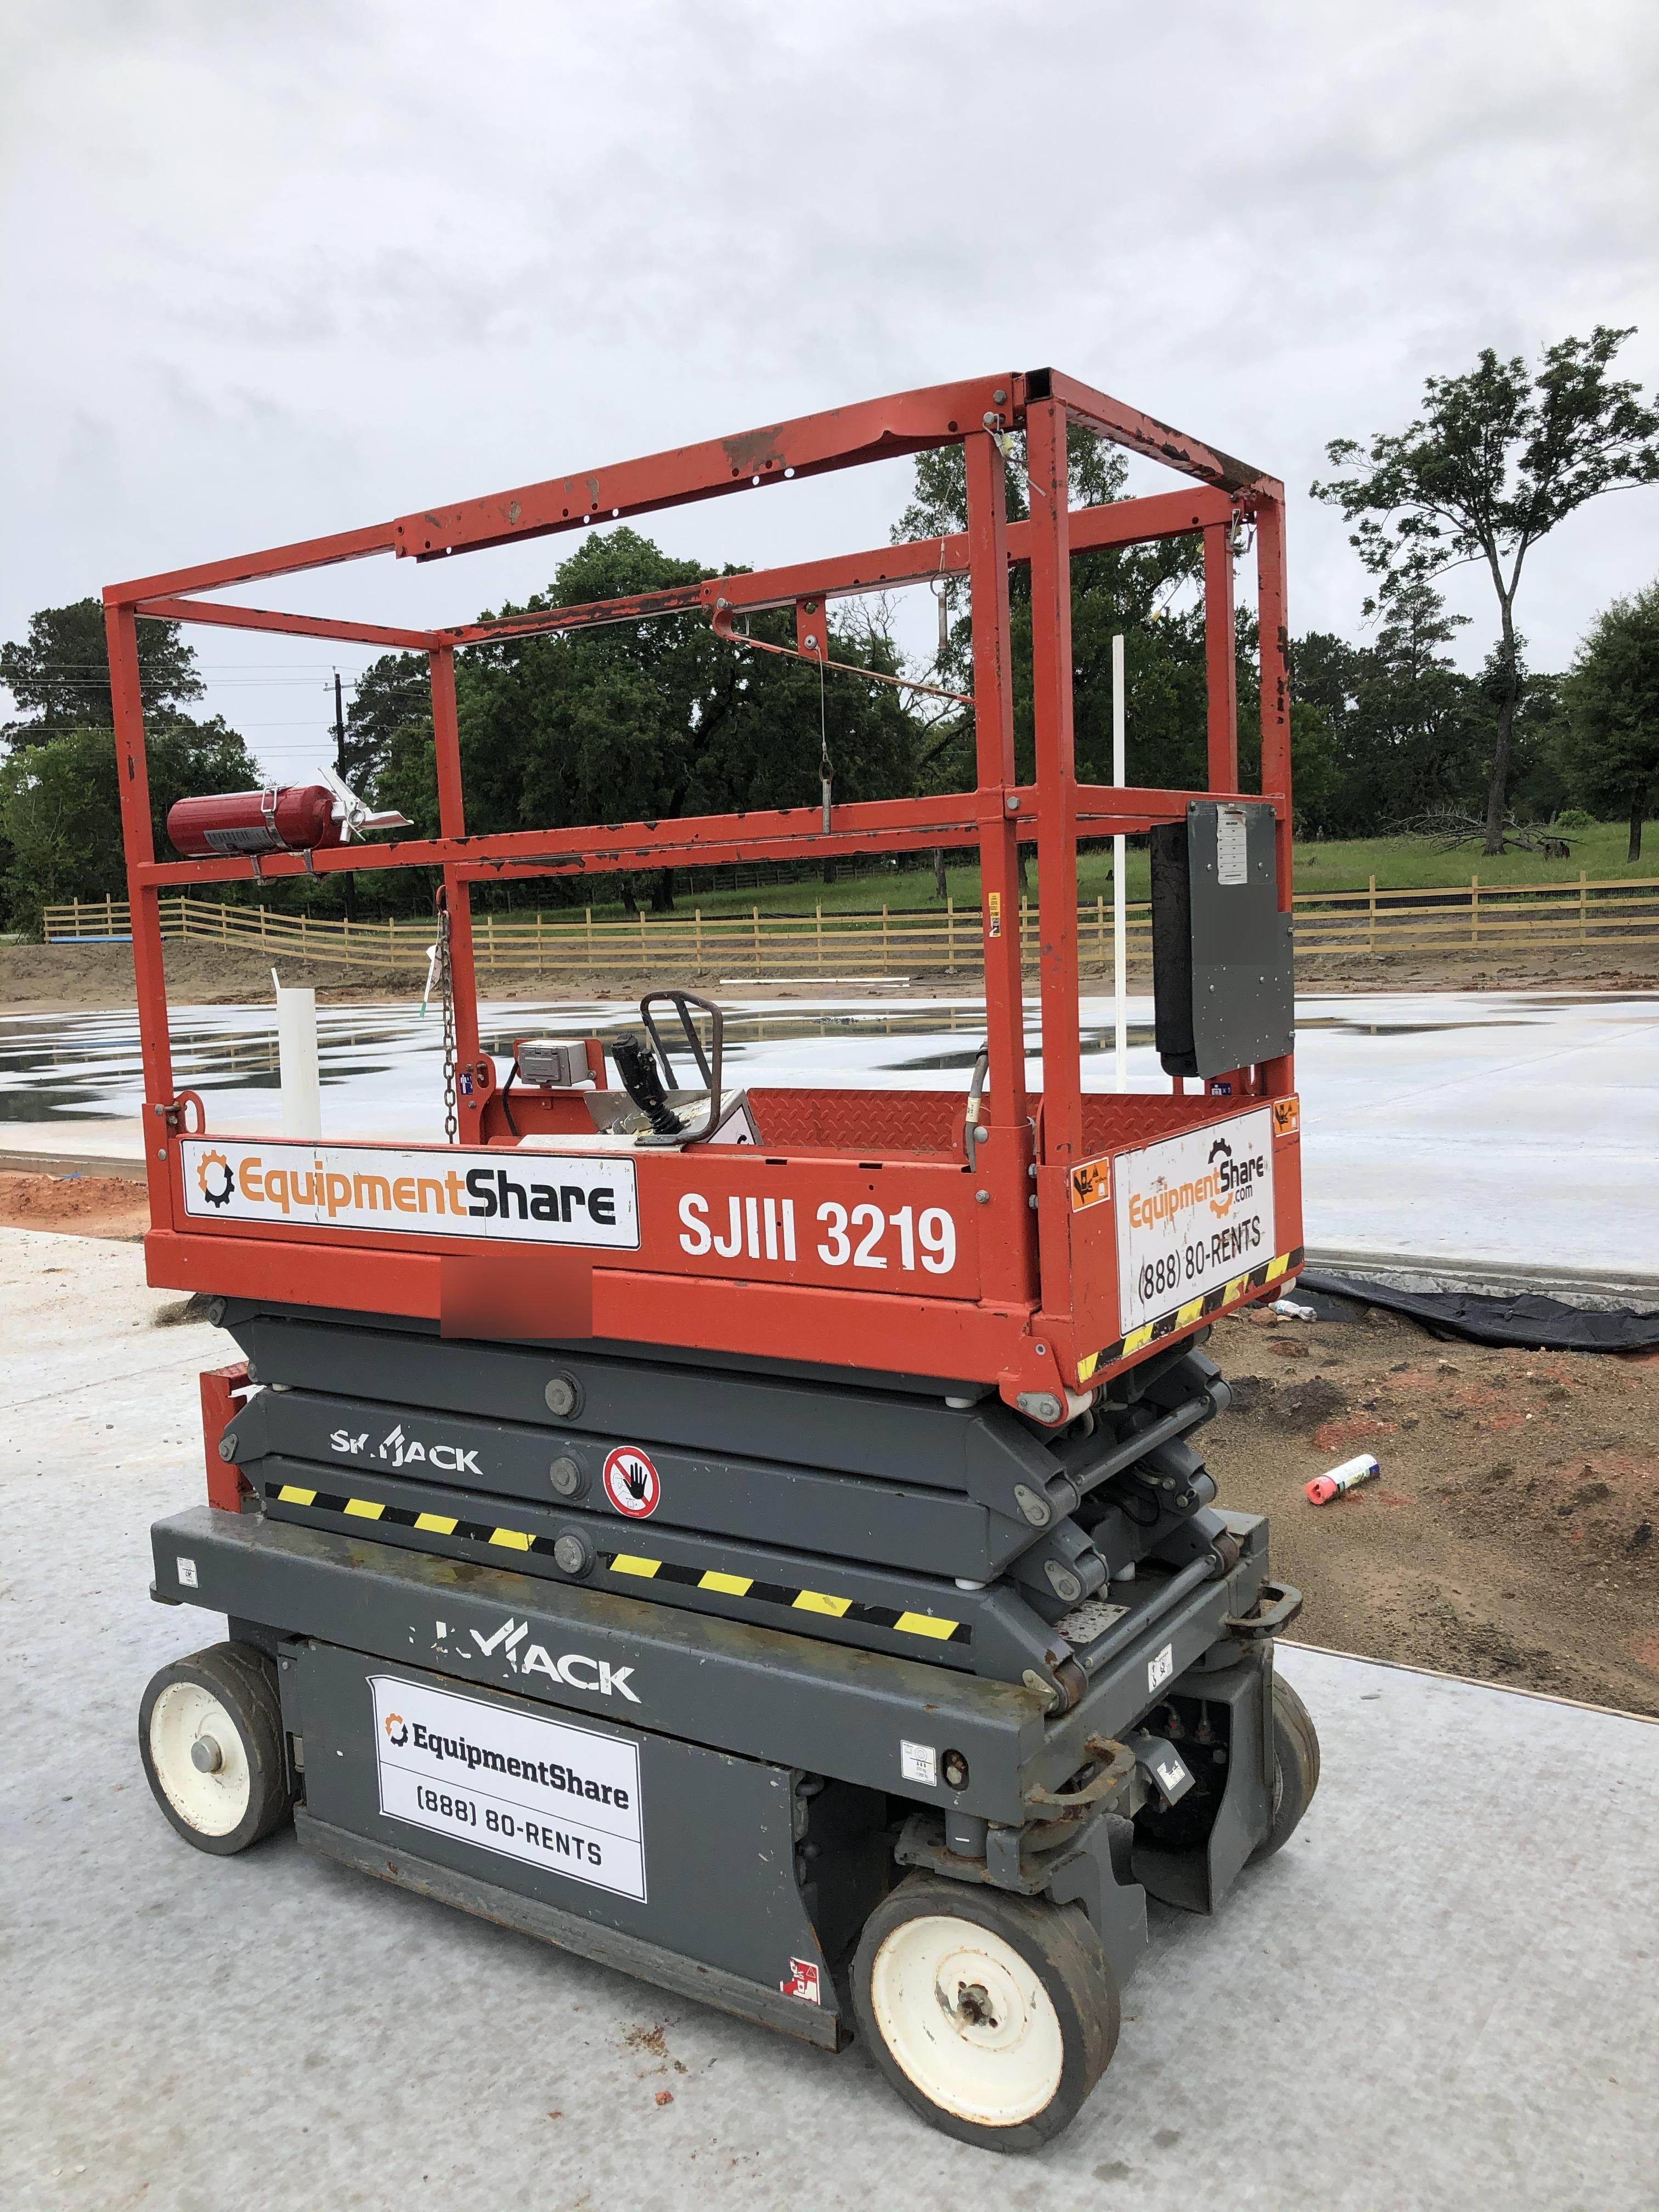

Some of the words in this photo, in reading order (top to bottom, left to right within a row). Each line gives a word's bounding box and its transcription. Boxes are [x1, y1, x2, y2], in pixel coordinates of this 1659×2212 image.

[239, 1157, 615, 1226] EquipmentShare
[1129, 1155, 1264, 1229] EquipmentShare
[679, 1193, 796, 1261] SJIII
[816, 1202, 956, 1274] 3219
[1138, 1249, 1181, 1305] (888)
[1186, 1215, 1261, 1280] 80-RENTS
[412, 1723, 629, 1810] EquipmentShare
[417, 1785, 476, 1826] (888)
[486, 1809, 602, 1866] 80-RENTS
